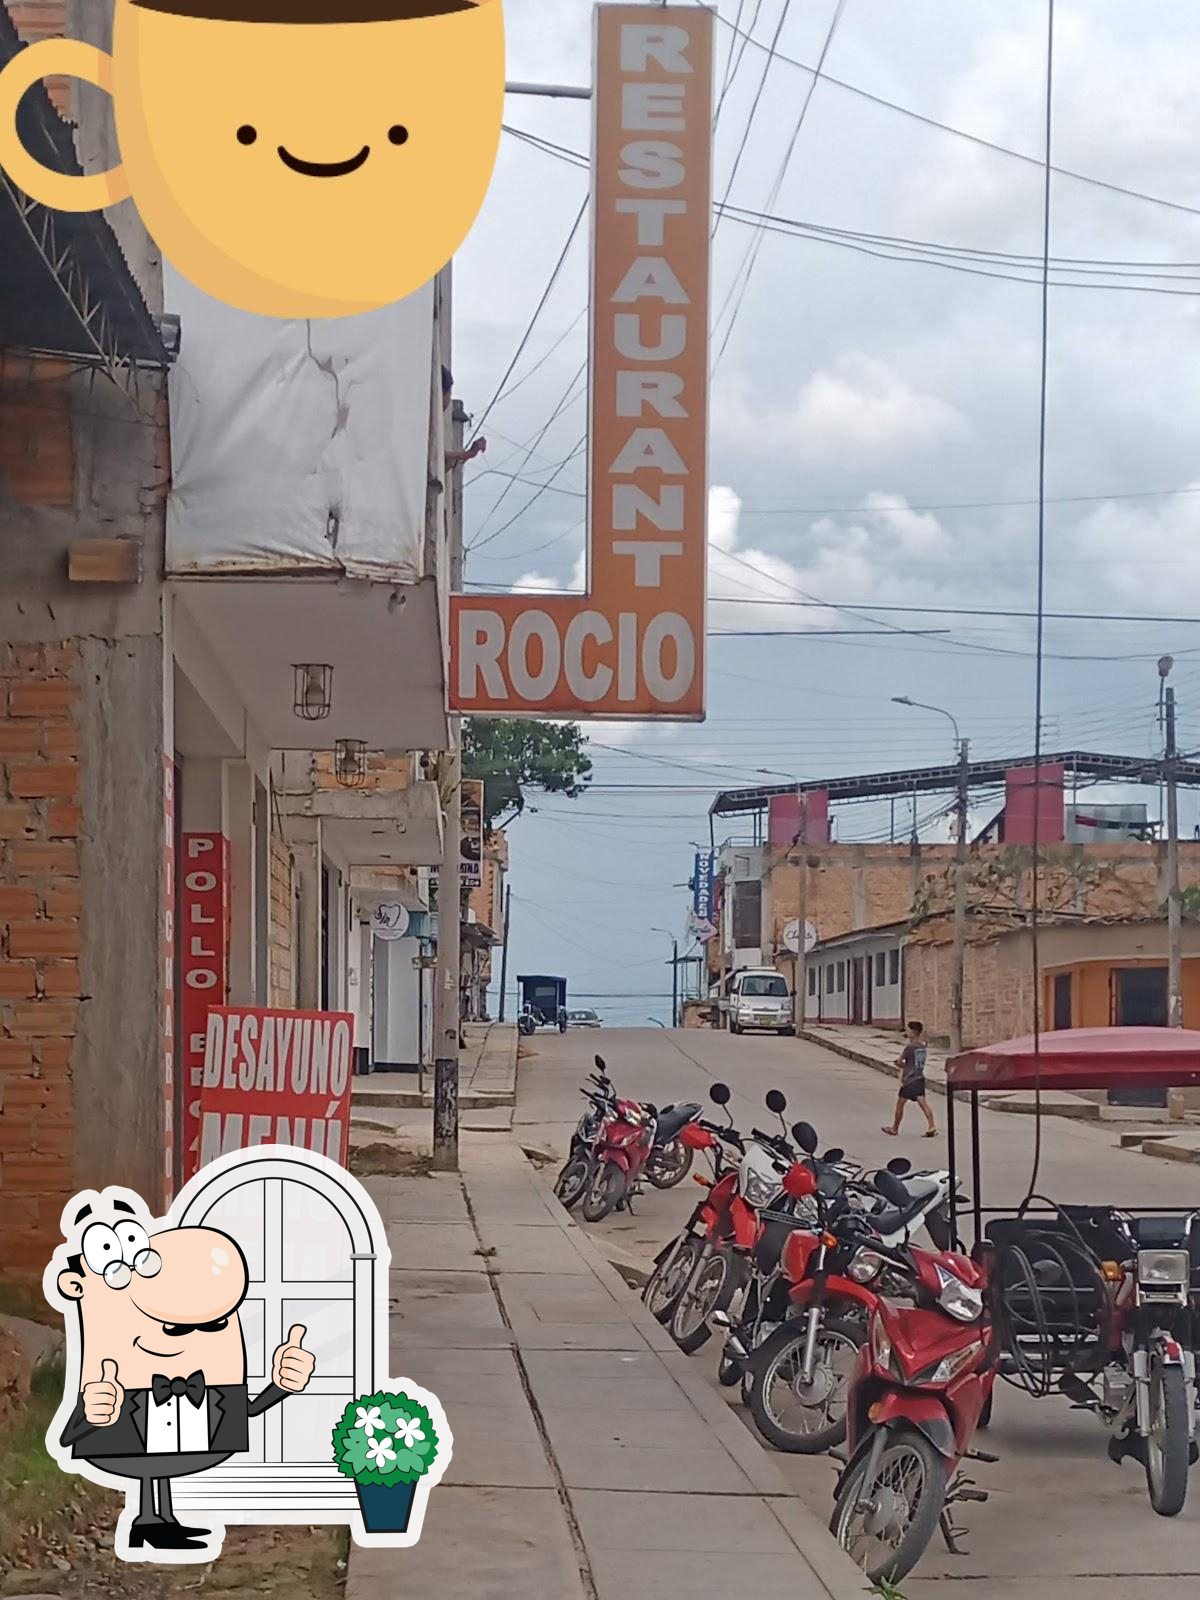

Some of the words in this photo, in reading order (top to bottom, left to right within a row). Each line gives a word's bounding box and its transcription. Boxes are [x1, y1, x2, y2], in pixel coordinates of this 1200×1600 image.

[609, 24, 695, 588] RESTAURANT
[458, 609, 695, 702] ROCIO
[185, 838, 217, 989] POLLO
[203, 1013, 349, 1097] DESAYUNO
